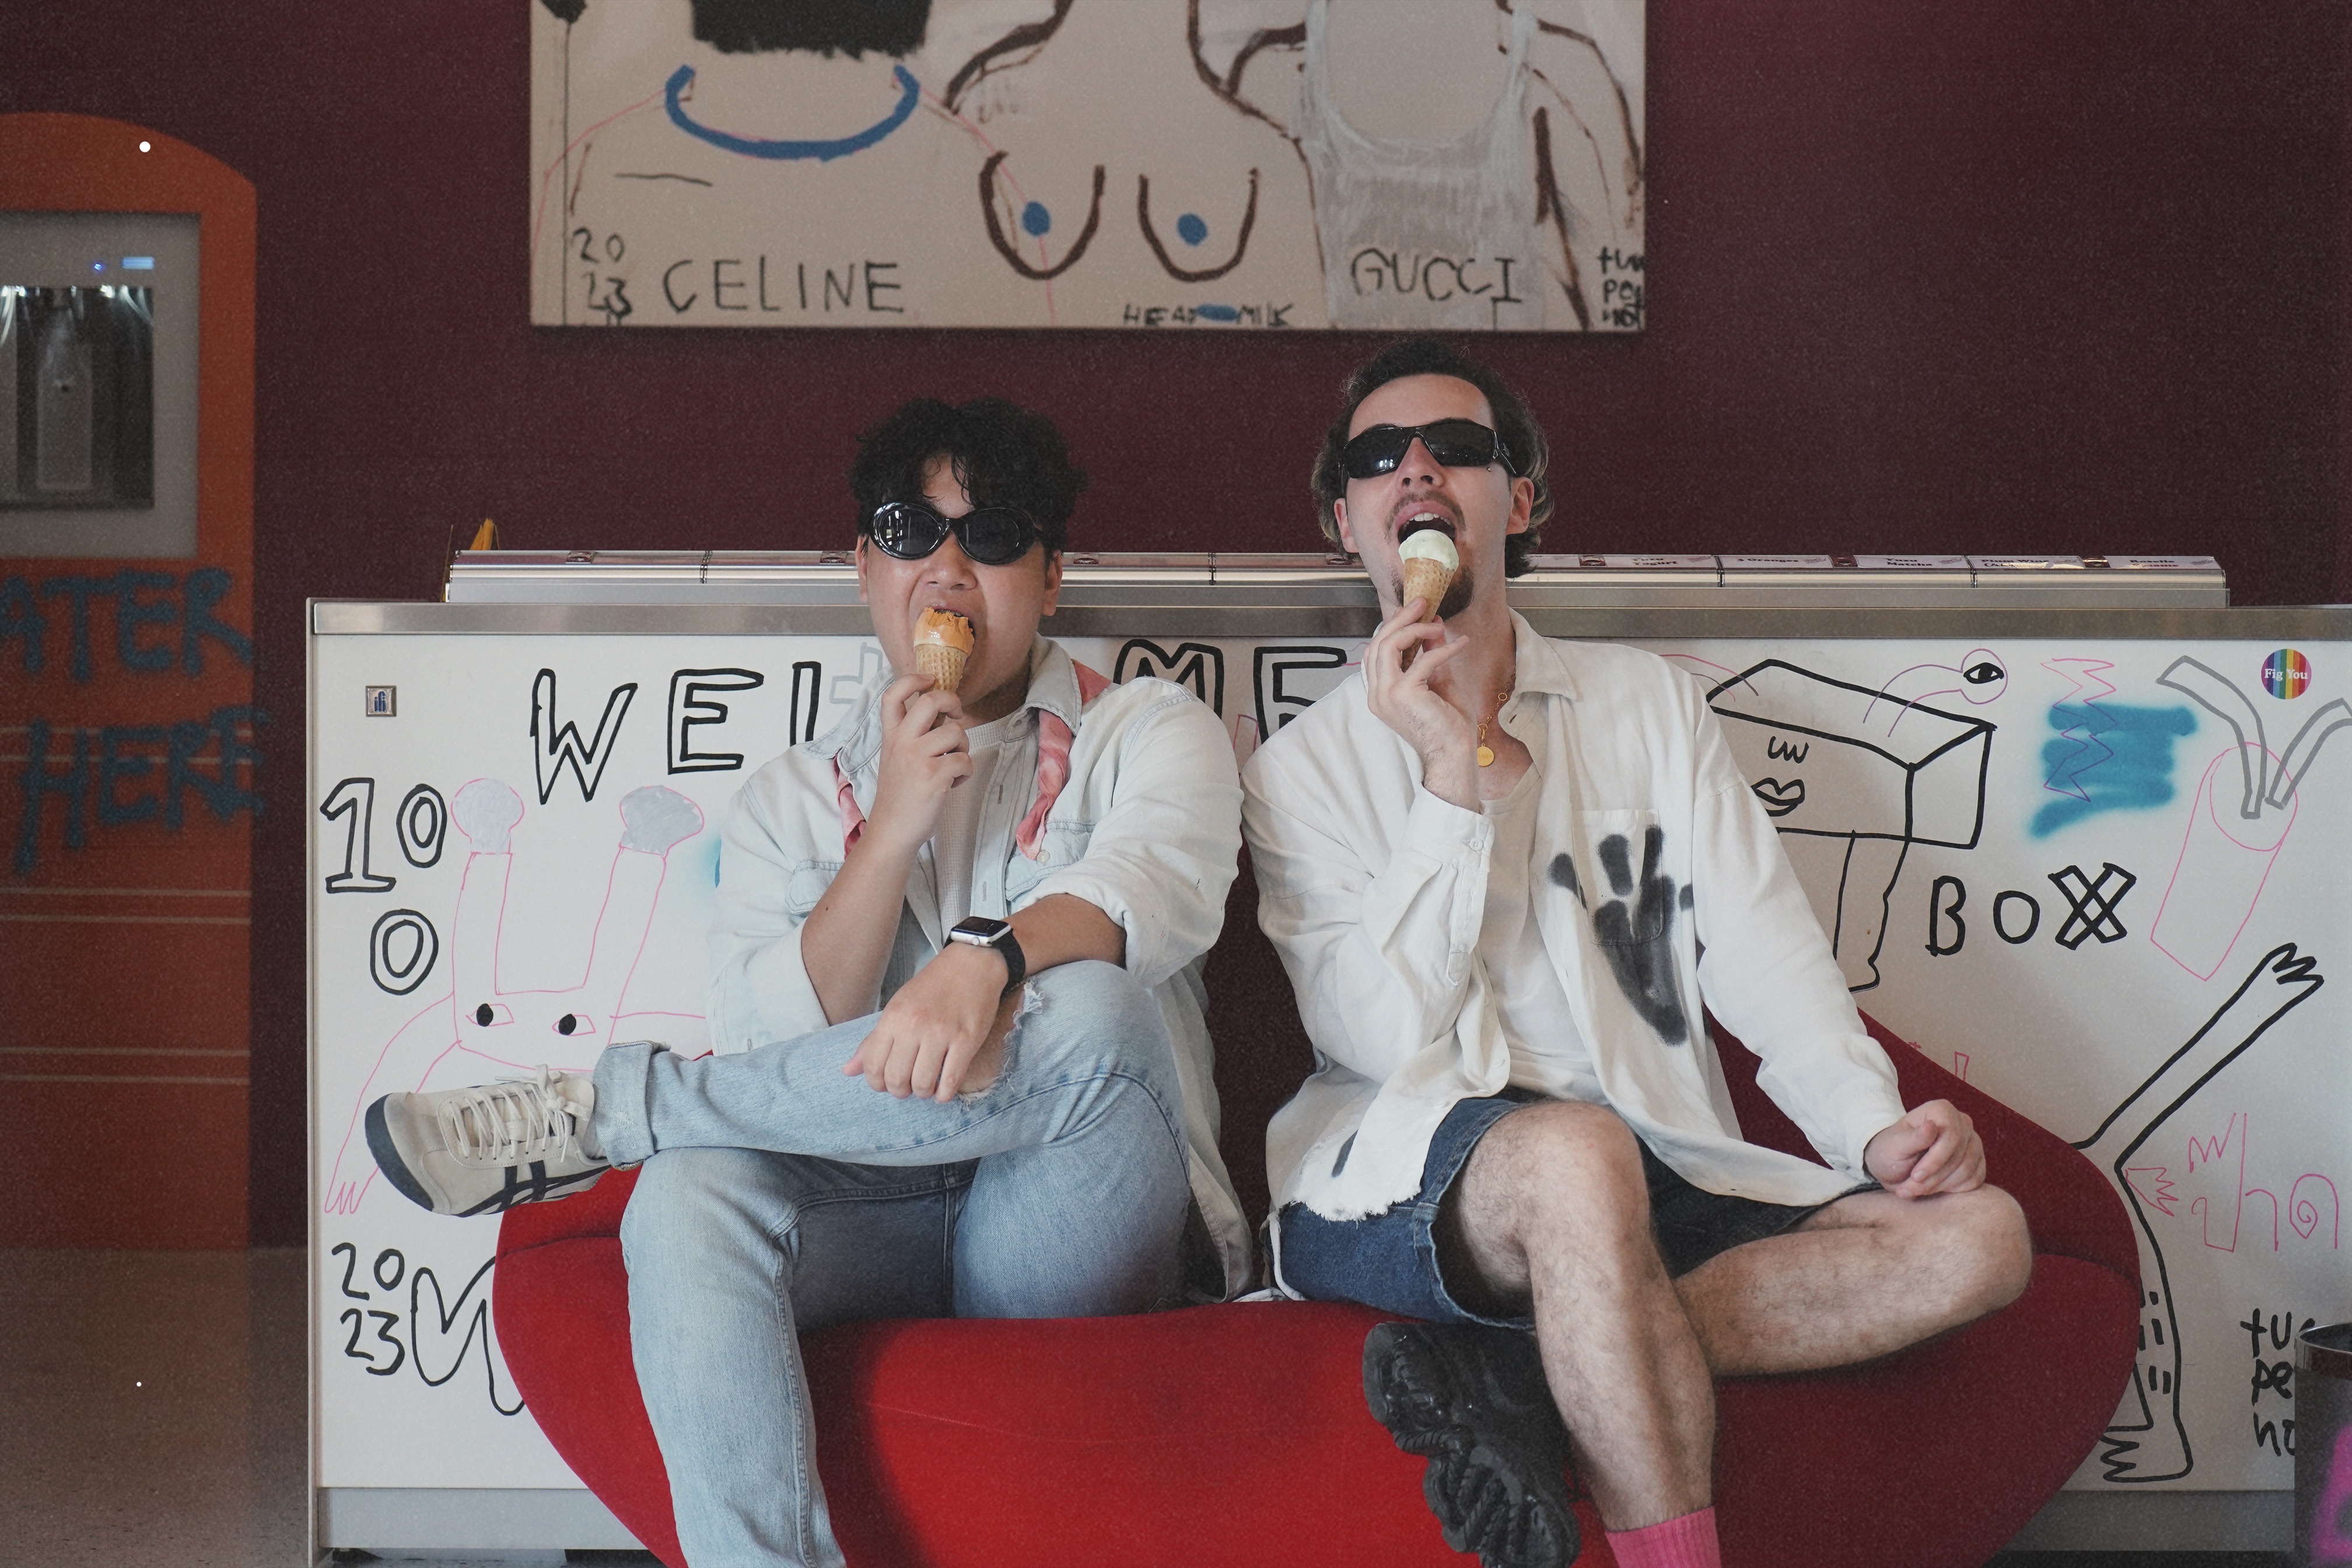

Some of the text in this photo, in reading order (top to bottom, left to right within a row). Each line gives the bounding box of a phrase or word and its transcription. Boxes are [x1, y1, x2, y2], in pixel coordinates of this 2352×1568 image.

[572, 226, 626, 264] 20
[580, 271, 634, 318] 23
[662, 255, 904, 313] CELINE
[1350, 247, 1522, 303] GUCCI
[2264, 668, 2308, 681] Fig You
[15, 705, 273, 876] HERE
[320, 777, 447, 893] 10
[331, 1241, 405, 1301] 20
[340, 1308, 405, 1376] 23
